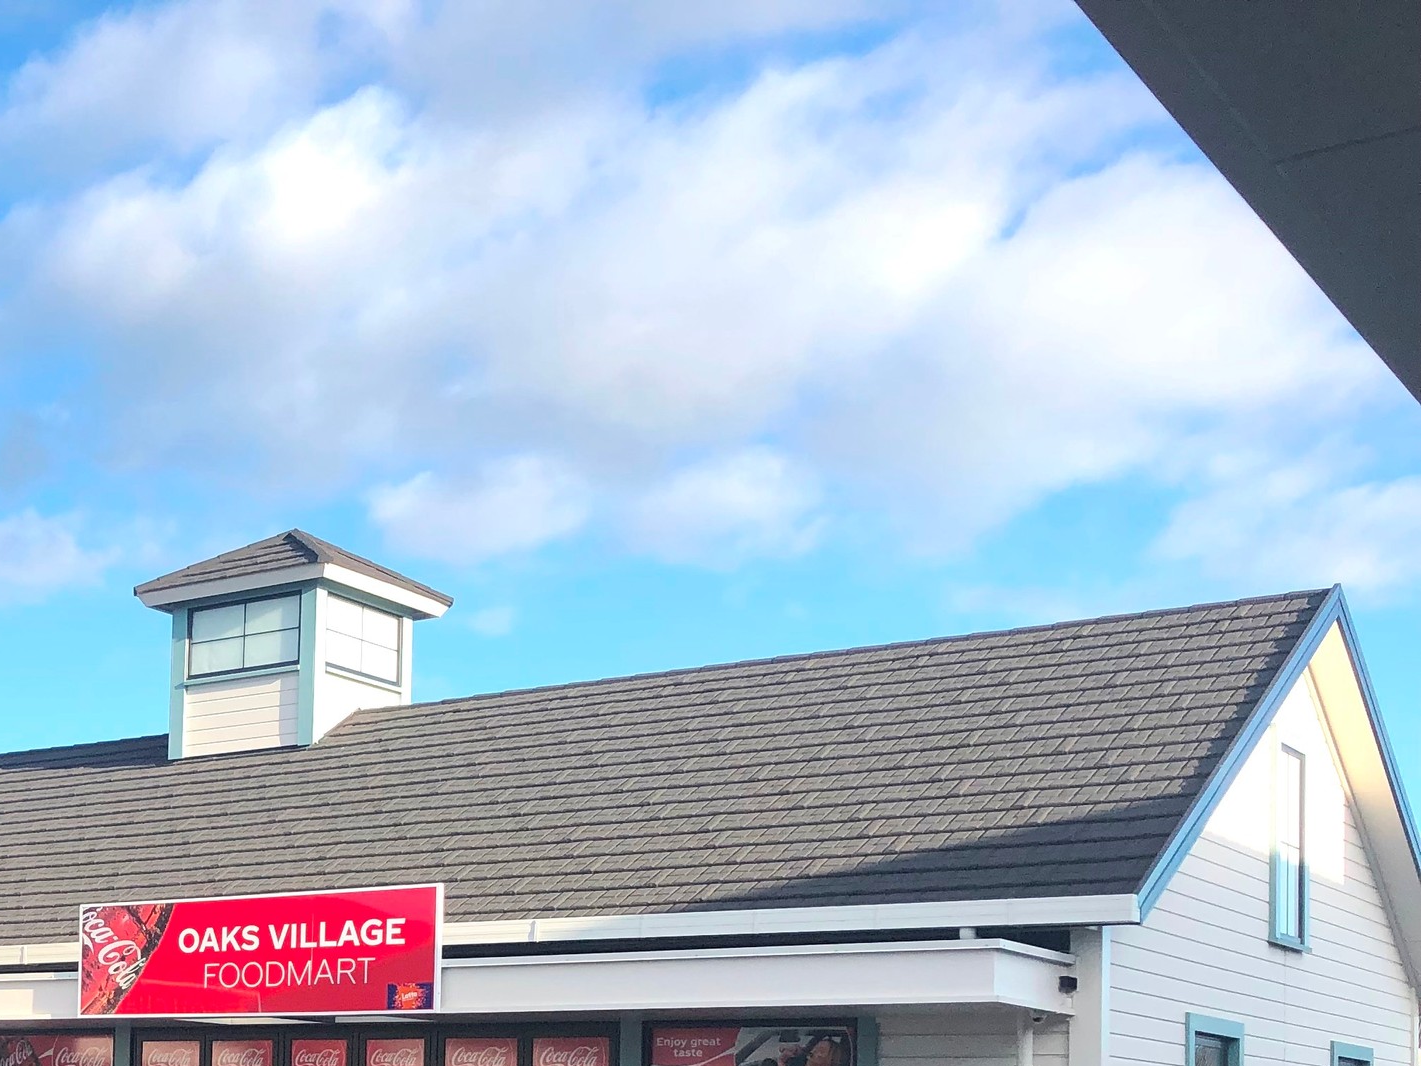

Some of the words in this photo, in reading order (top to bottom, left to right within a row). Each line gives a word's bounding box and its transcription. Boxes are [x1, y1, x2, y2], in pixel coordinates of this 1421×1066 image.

[178, 926, 260, 954] OAKS
[268, 918, 406, 950] VILLAGE
[203, 957, 376, 989] FOODMART
[656, 1037, 687, 1048] Enjoy
[690, 1037, 722, 1048] great
[148, 1049, 193, 1066] Coca-Cola
[295, 1049, 341, 1066] Coca-Cola
[370, 1048, 421, 1066] Coca-Cola
[673, 1048, 703, 1057] taste
